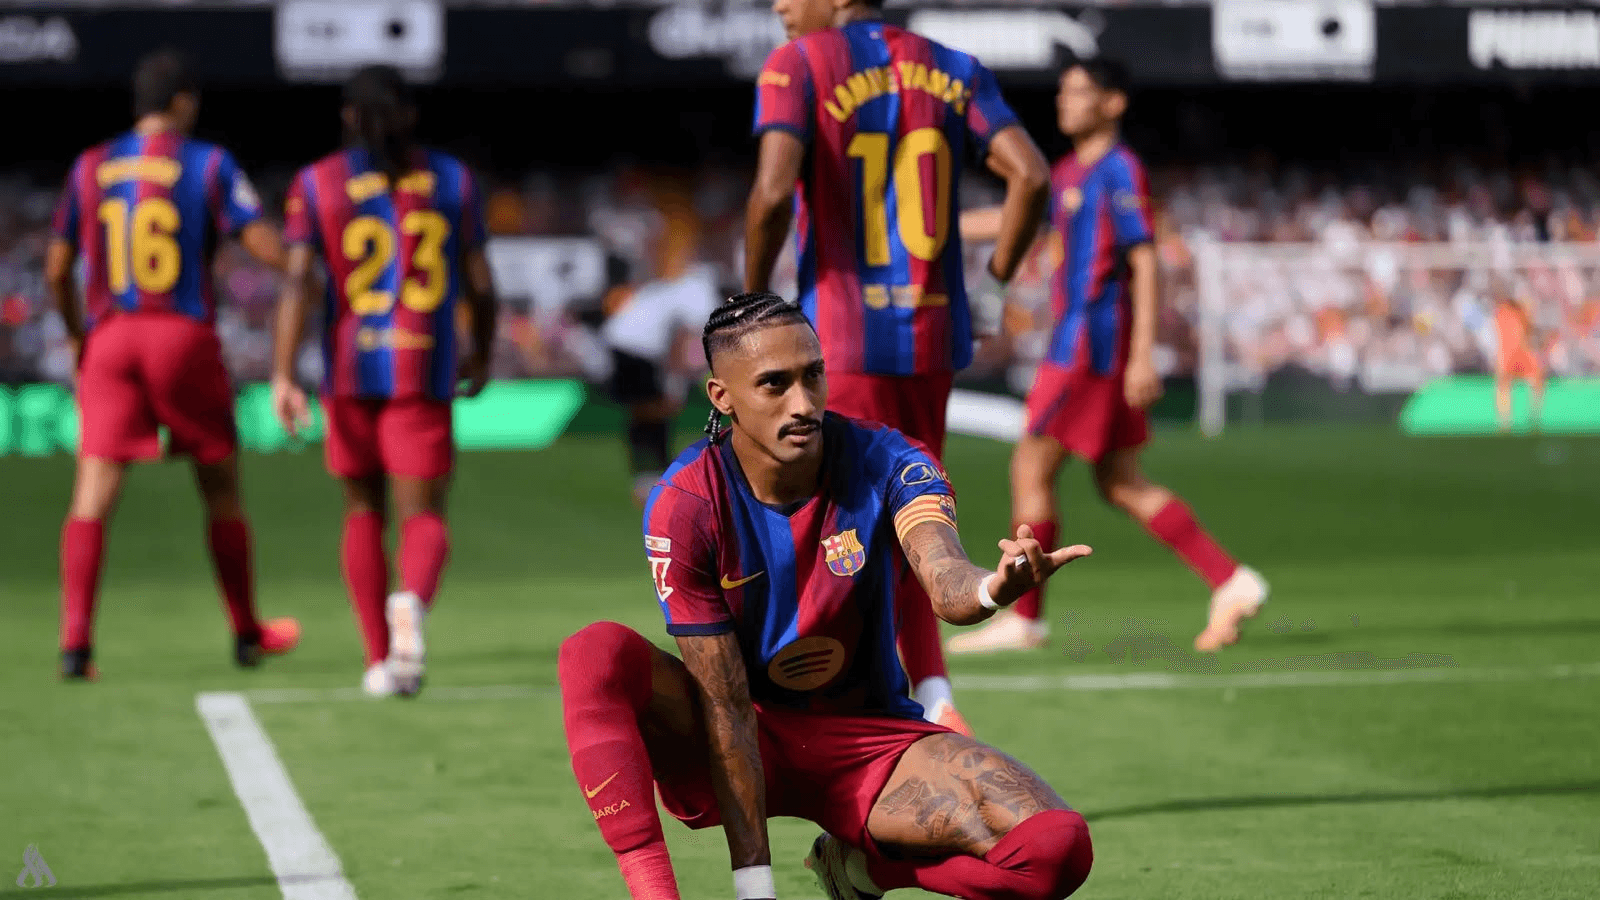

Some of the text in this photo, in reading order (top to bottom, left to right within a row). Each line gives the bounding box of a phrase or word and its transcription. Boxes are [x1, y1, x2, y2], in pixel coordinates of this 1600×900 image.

[98, 198, 181, 293] 16
[847, 127, 951, 266] 10
[343, 211, 448, 315] 23
